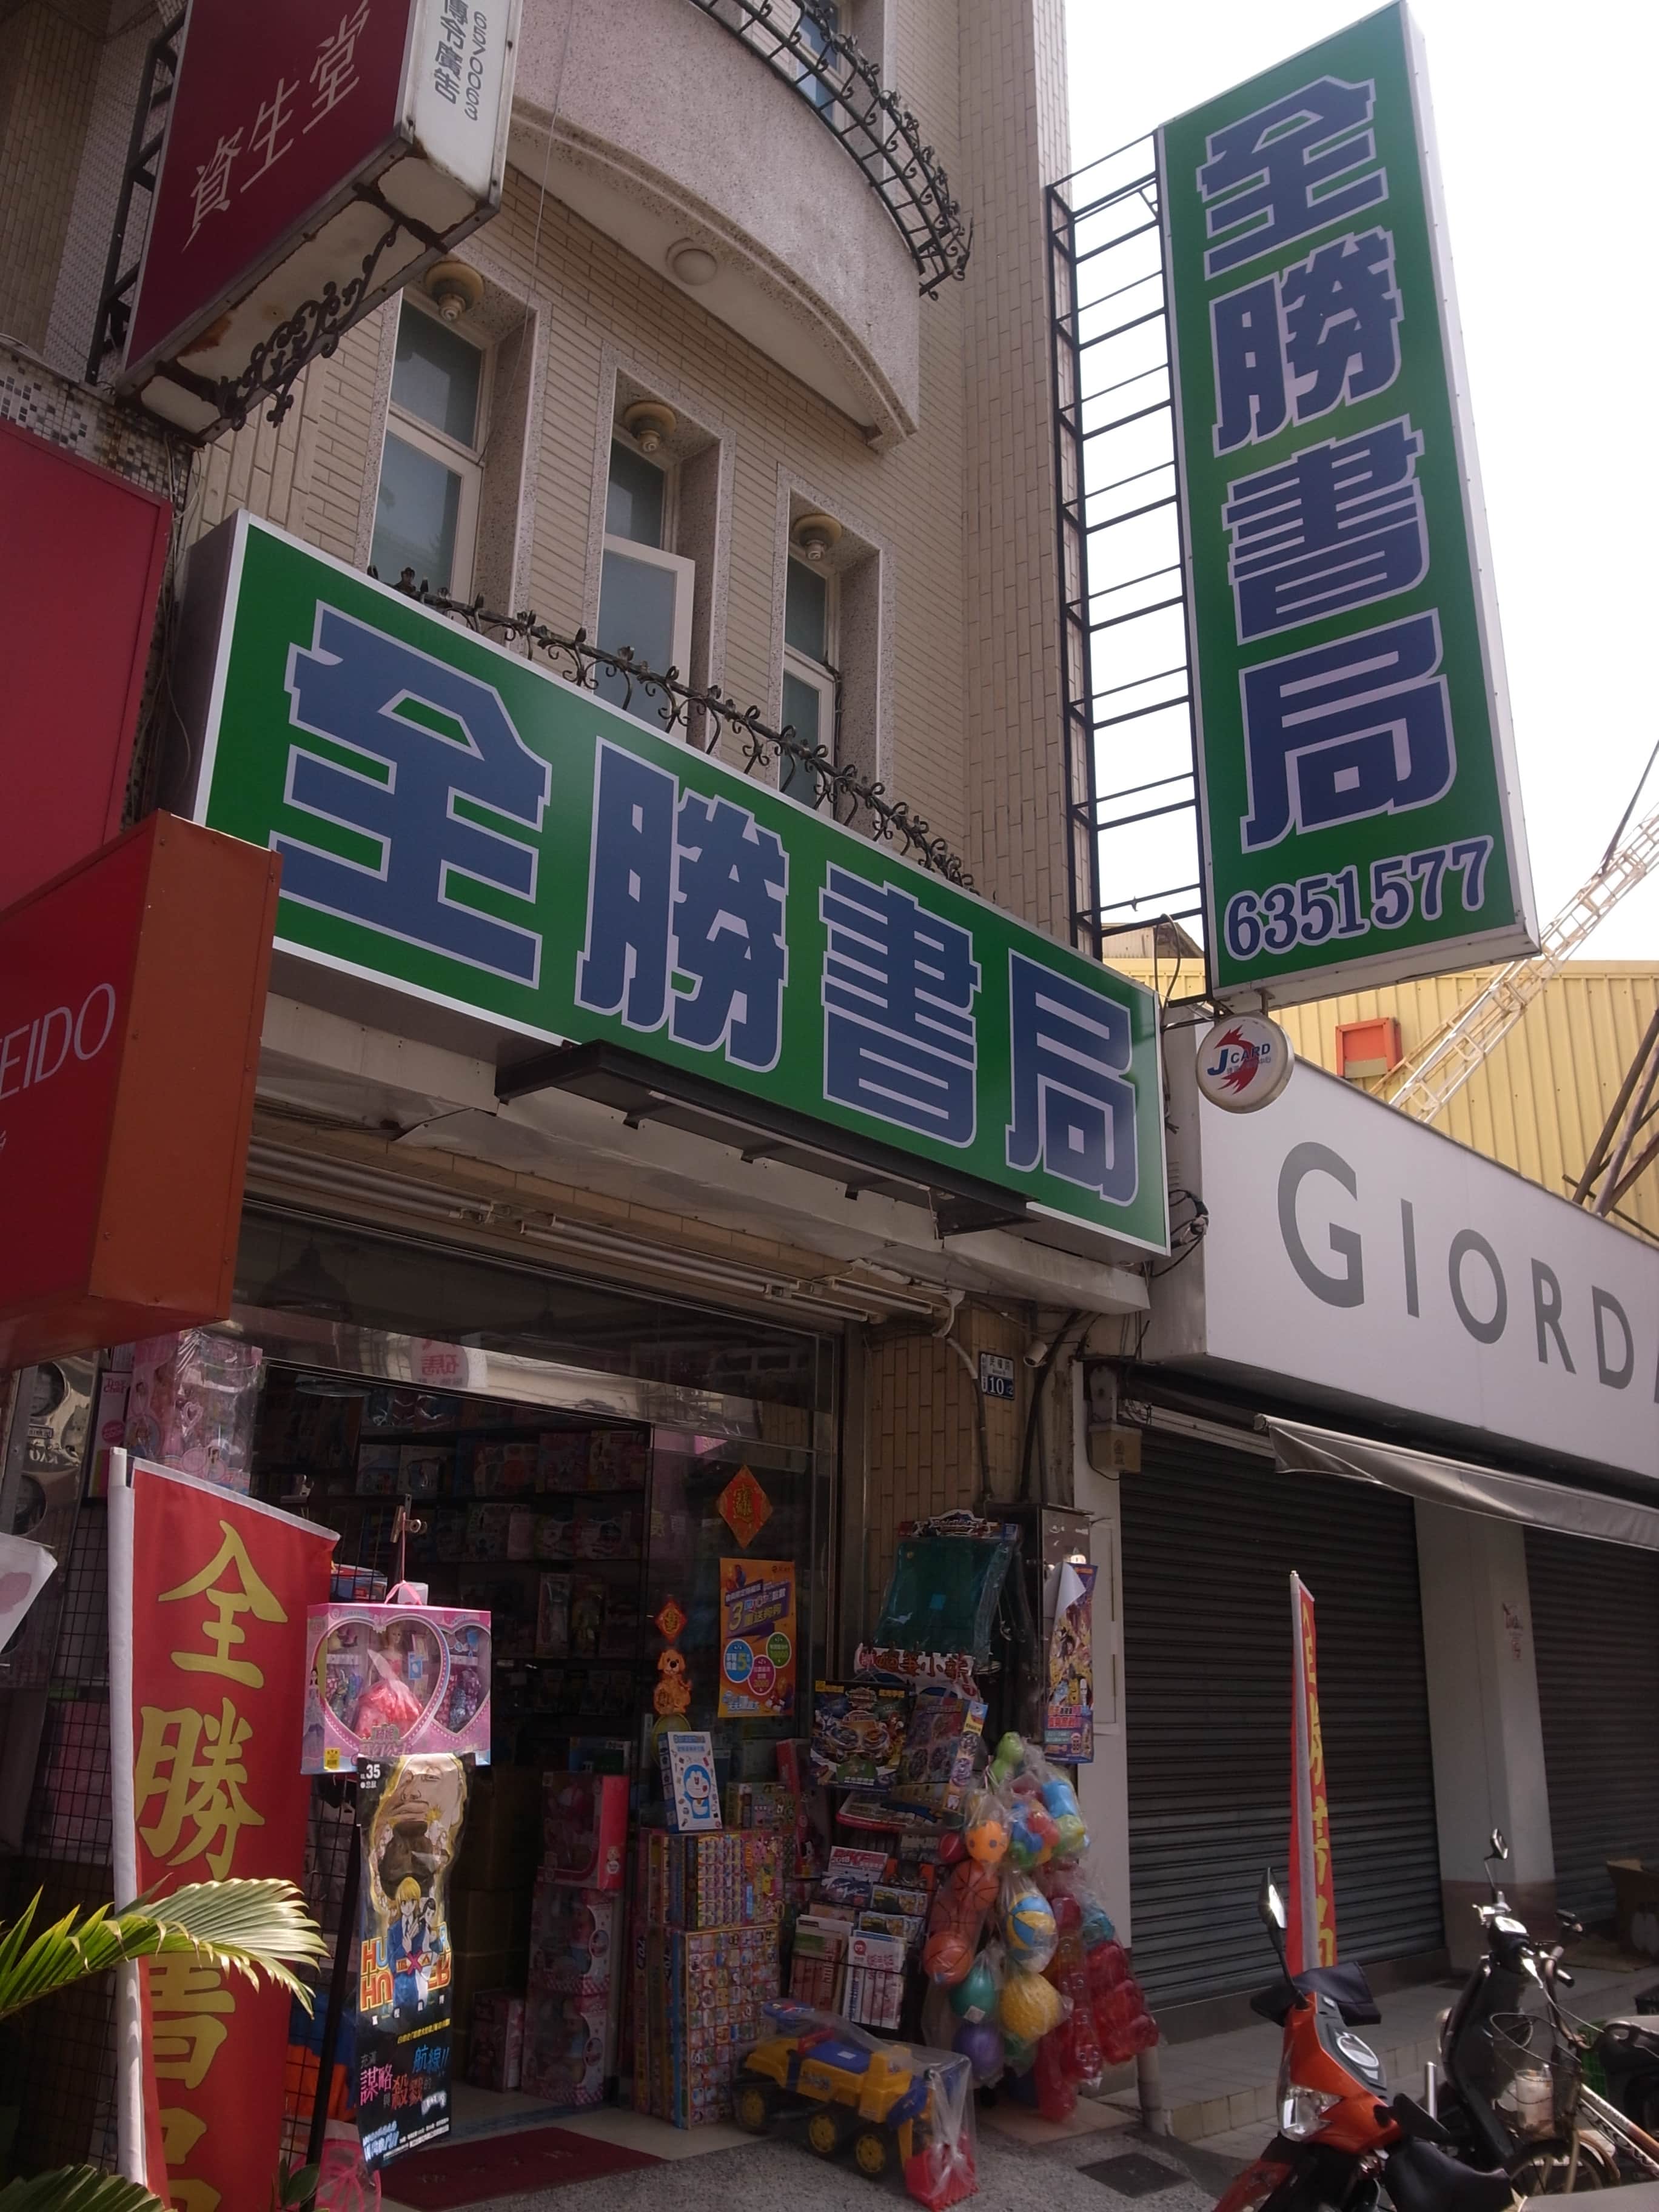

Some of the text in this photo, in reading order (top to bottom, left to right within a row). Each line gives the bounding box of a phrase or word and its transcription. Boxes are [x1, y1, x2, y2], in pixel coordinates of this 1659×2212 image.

[182, 0, 371, 252] 資生堂
[464, 11, 487, 121] 6570063
[1196, 75, 1458, 854] 全勝書局
[269, 599, 1139, 1207] 全勝書局
[1224, 835, 1494, 961] 6351577
[0, 983, 116, 1101] EIDO
[1278, 1142, 1659, 1404] GIORD
[989, 1376, 1004, 1395] 10
[366, 1763, 381, 1779] 35
